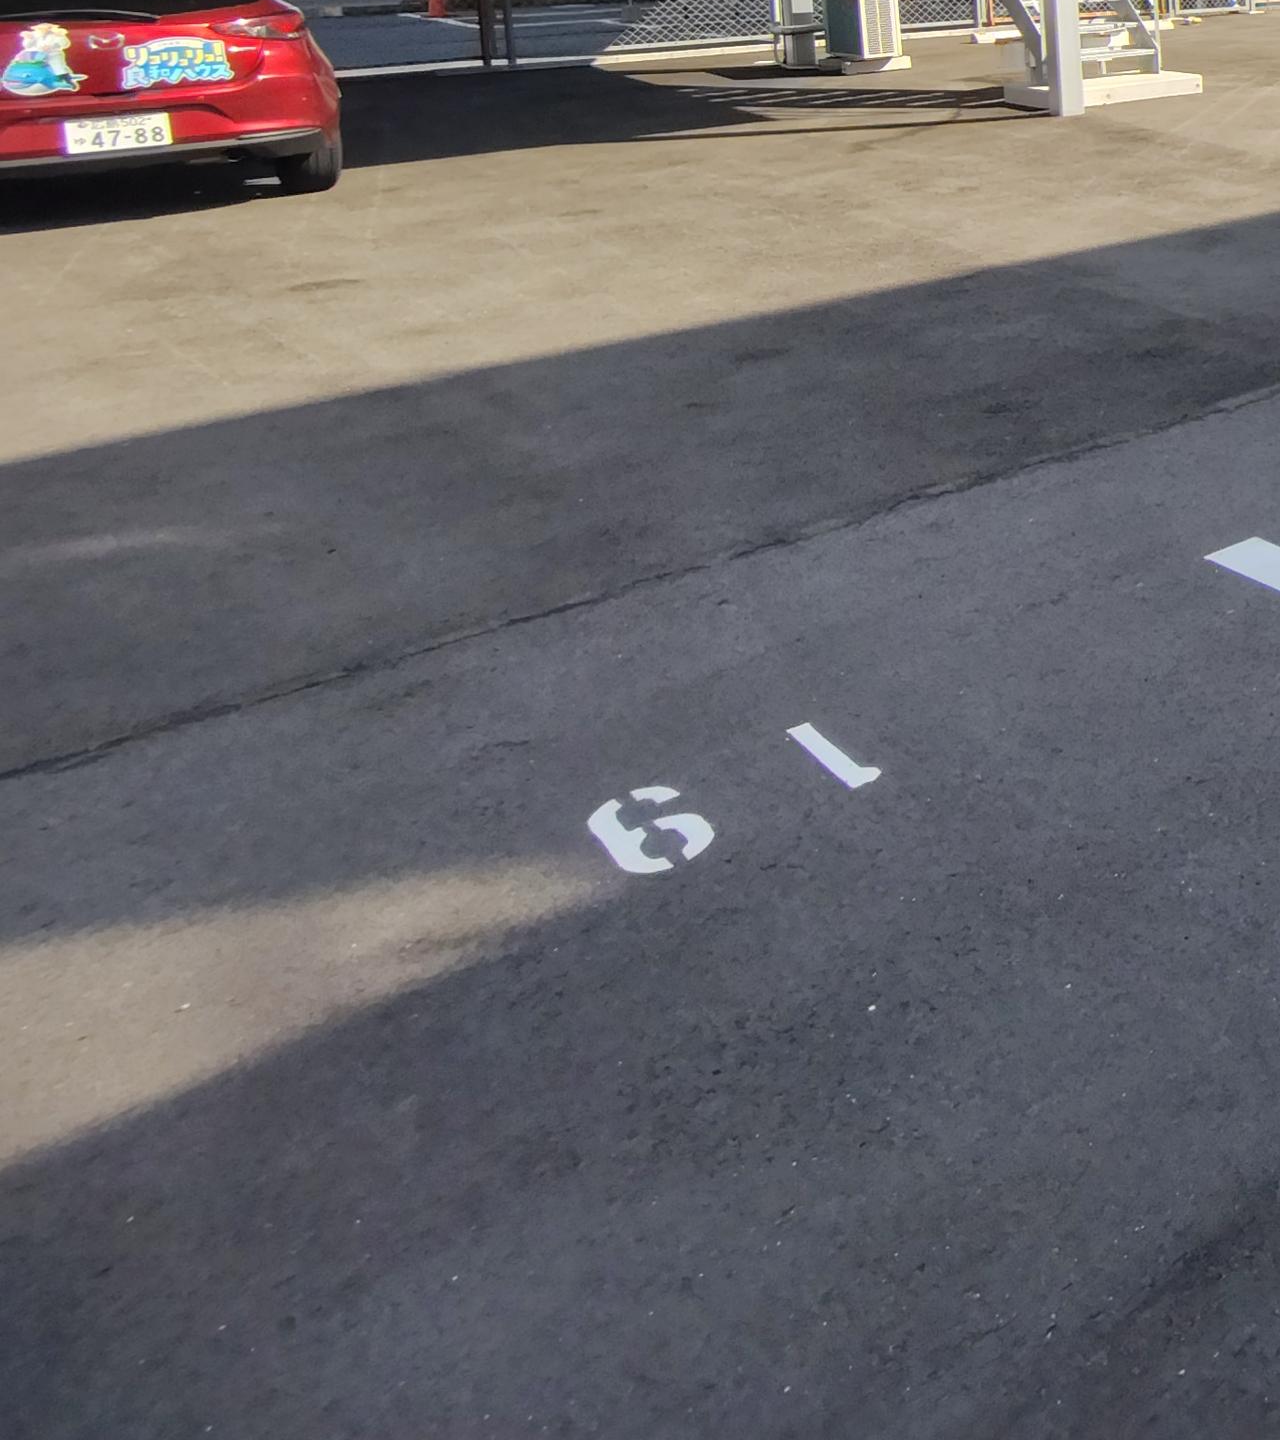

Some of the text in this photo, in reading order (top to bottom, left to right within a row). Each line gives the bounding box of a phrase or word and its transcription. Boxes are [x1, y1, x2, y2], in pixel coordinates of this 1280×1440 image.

[125, 63, 232, 87] 良和ハウス
[91, 126, 165, 148] 47-88
